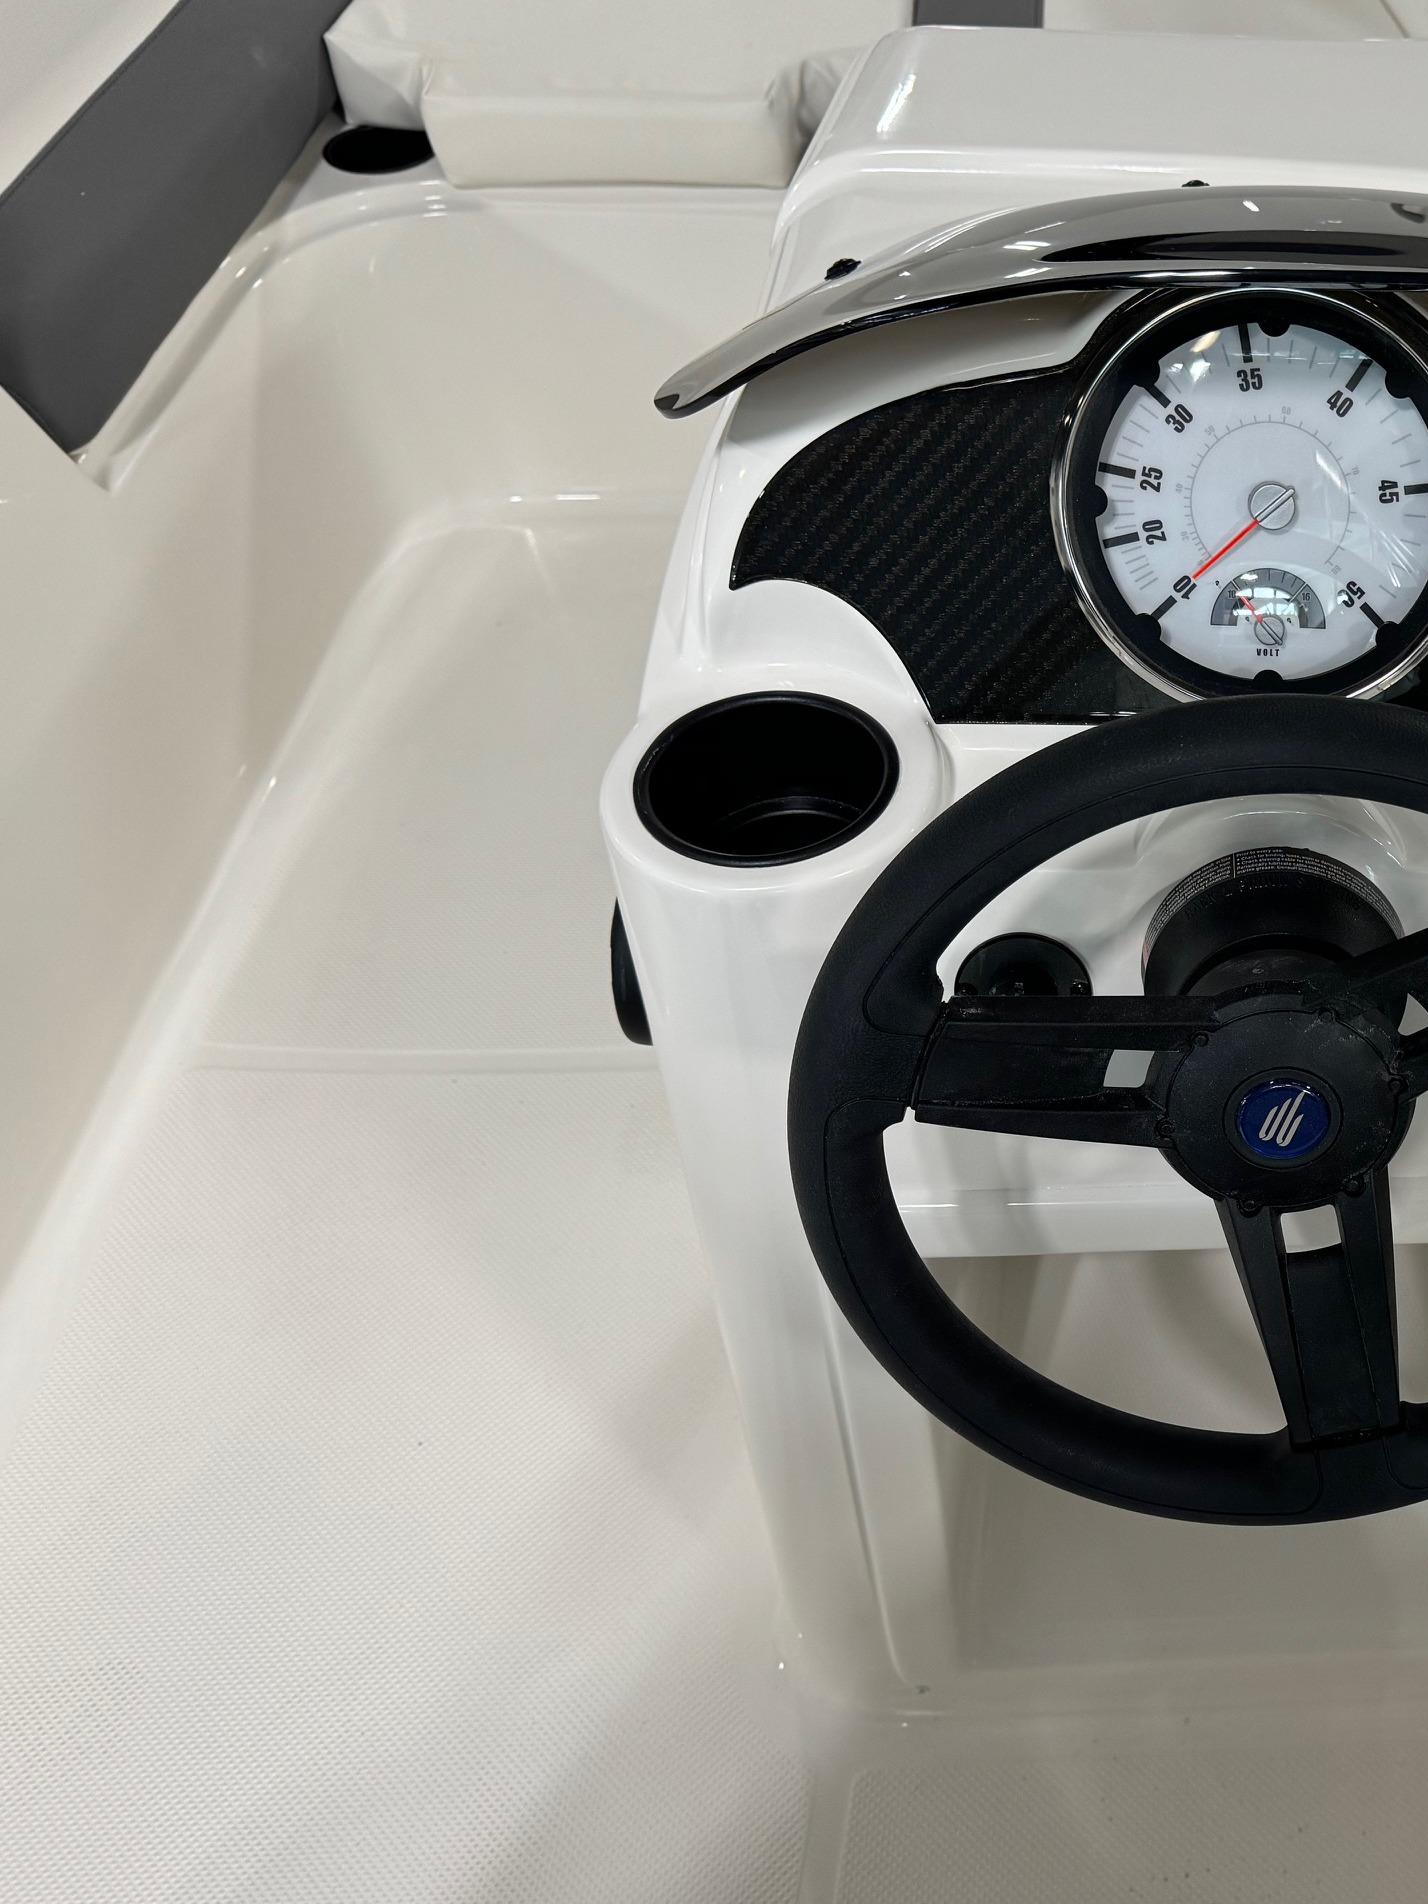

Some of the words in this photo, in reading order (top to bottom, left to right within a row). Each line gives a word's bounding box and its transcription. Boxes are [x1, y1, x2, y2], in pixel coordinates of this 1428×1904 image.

[1237, 368, 1263, 392] 35
[1326, 390, 1353, 417] 40
[1165, 403, 1194, 433] 30
[1140, 466, 1163, 492] 25
[1378, 480, 1400, 504] 45
[1142, 519, 1167, 545] 20
[1172, 575, 1197, 600] 10
[1301, 592, 1310, 601] 16
[1256, 649, 1280, 657] VOLT
